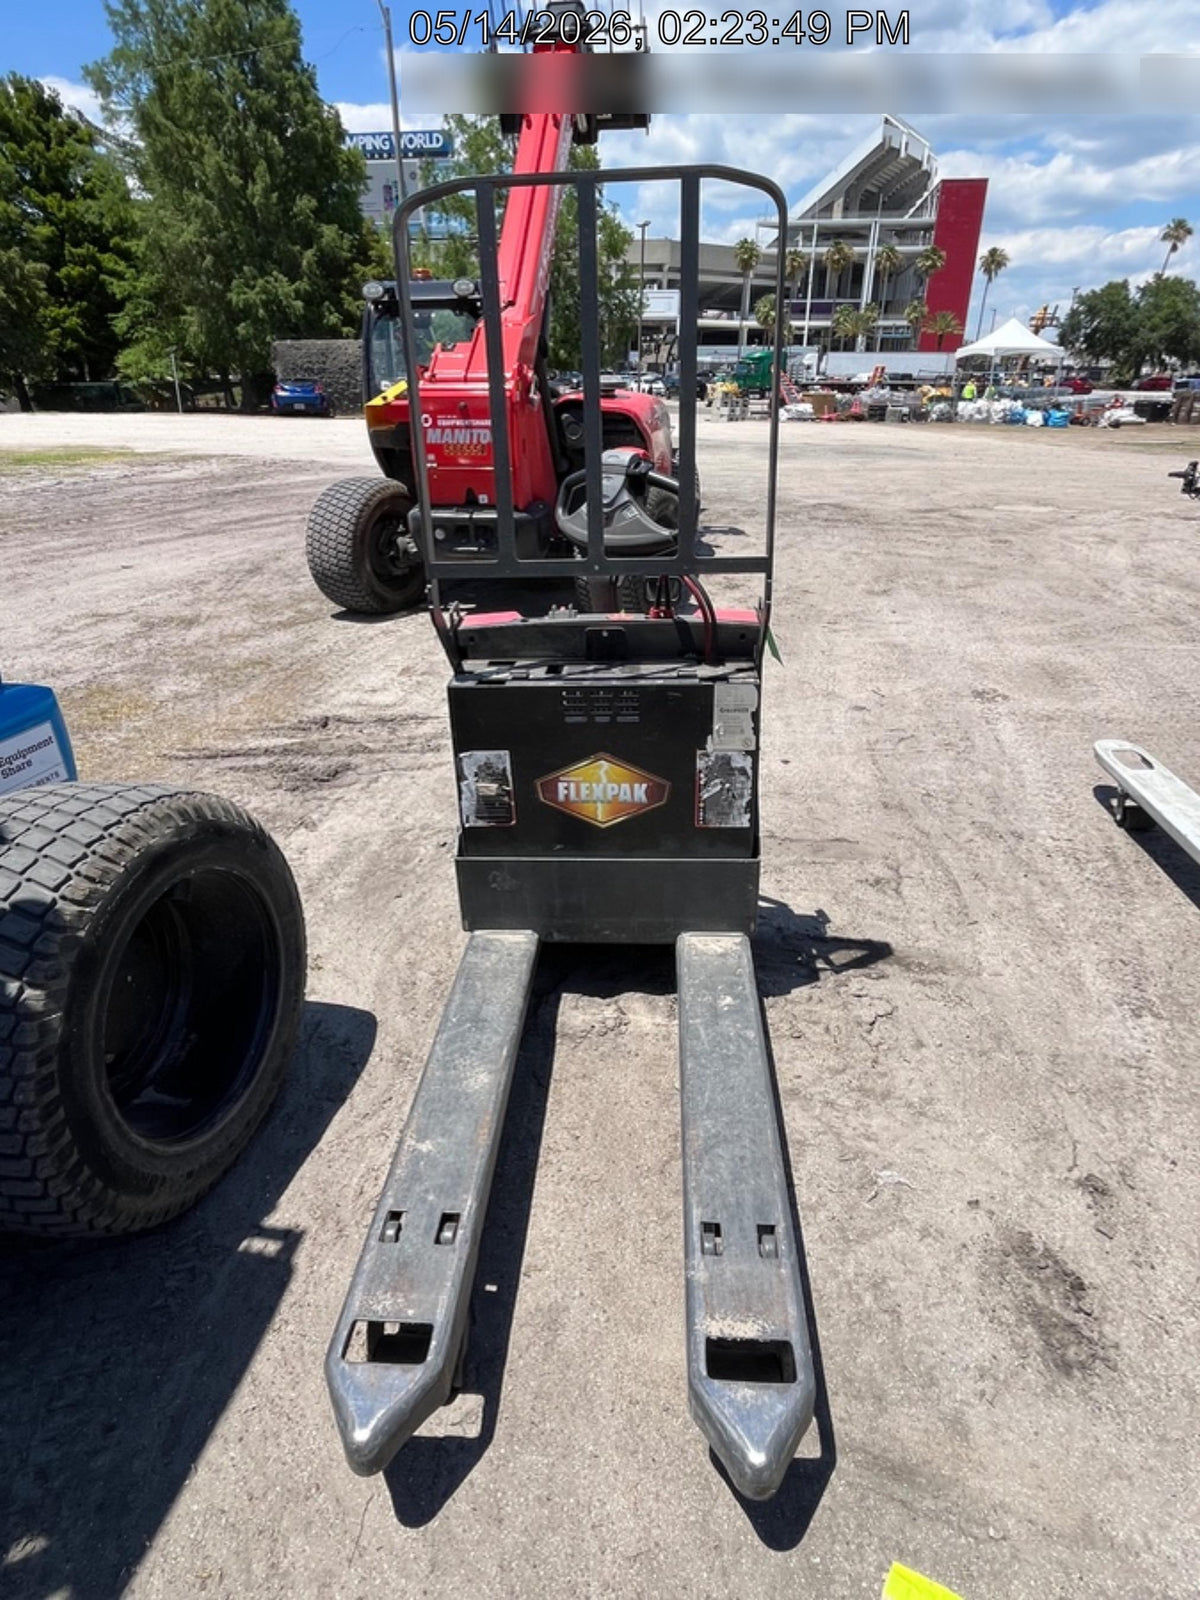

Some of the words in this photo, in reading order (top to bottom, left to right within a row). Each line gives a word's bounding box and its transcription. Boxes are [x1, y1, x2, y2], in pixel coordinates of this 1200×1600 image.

[341, 134, 390, 150] MPING
[426, 428, 493, 444] MANITO
[0, 735, 54, 768] Equipment
[1, 759, 33, 779] Share
[557, 782, 648, 803] FLEXPAK
